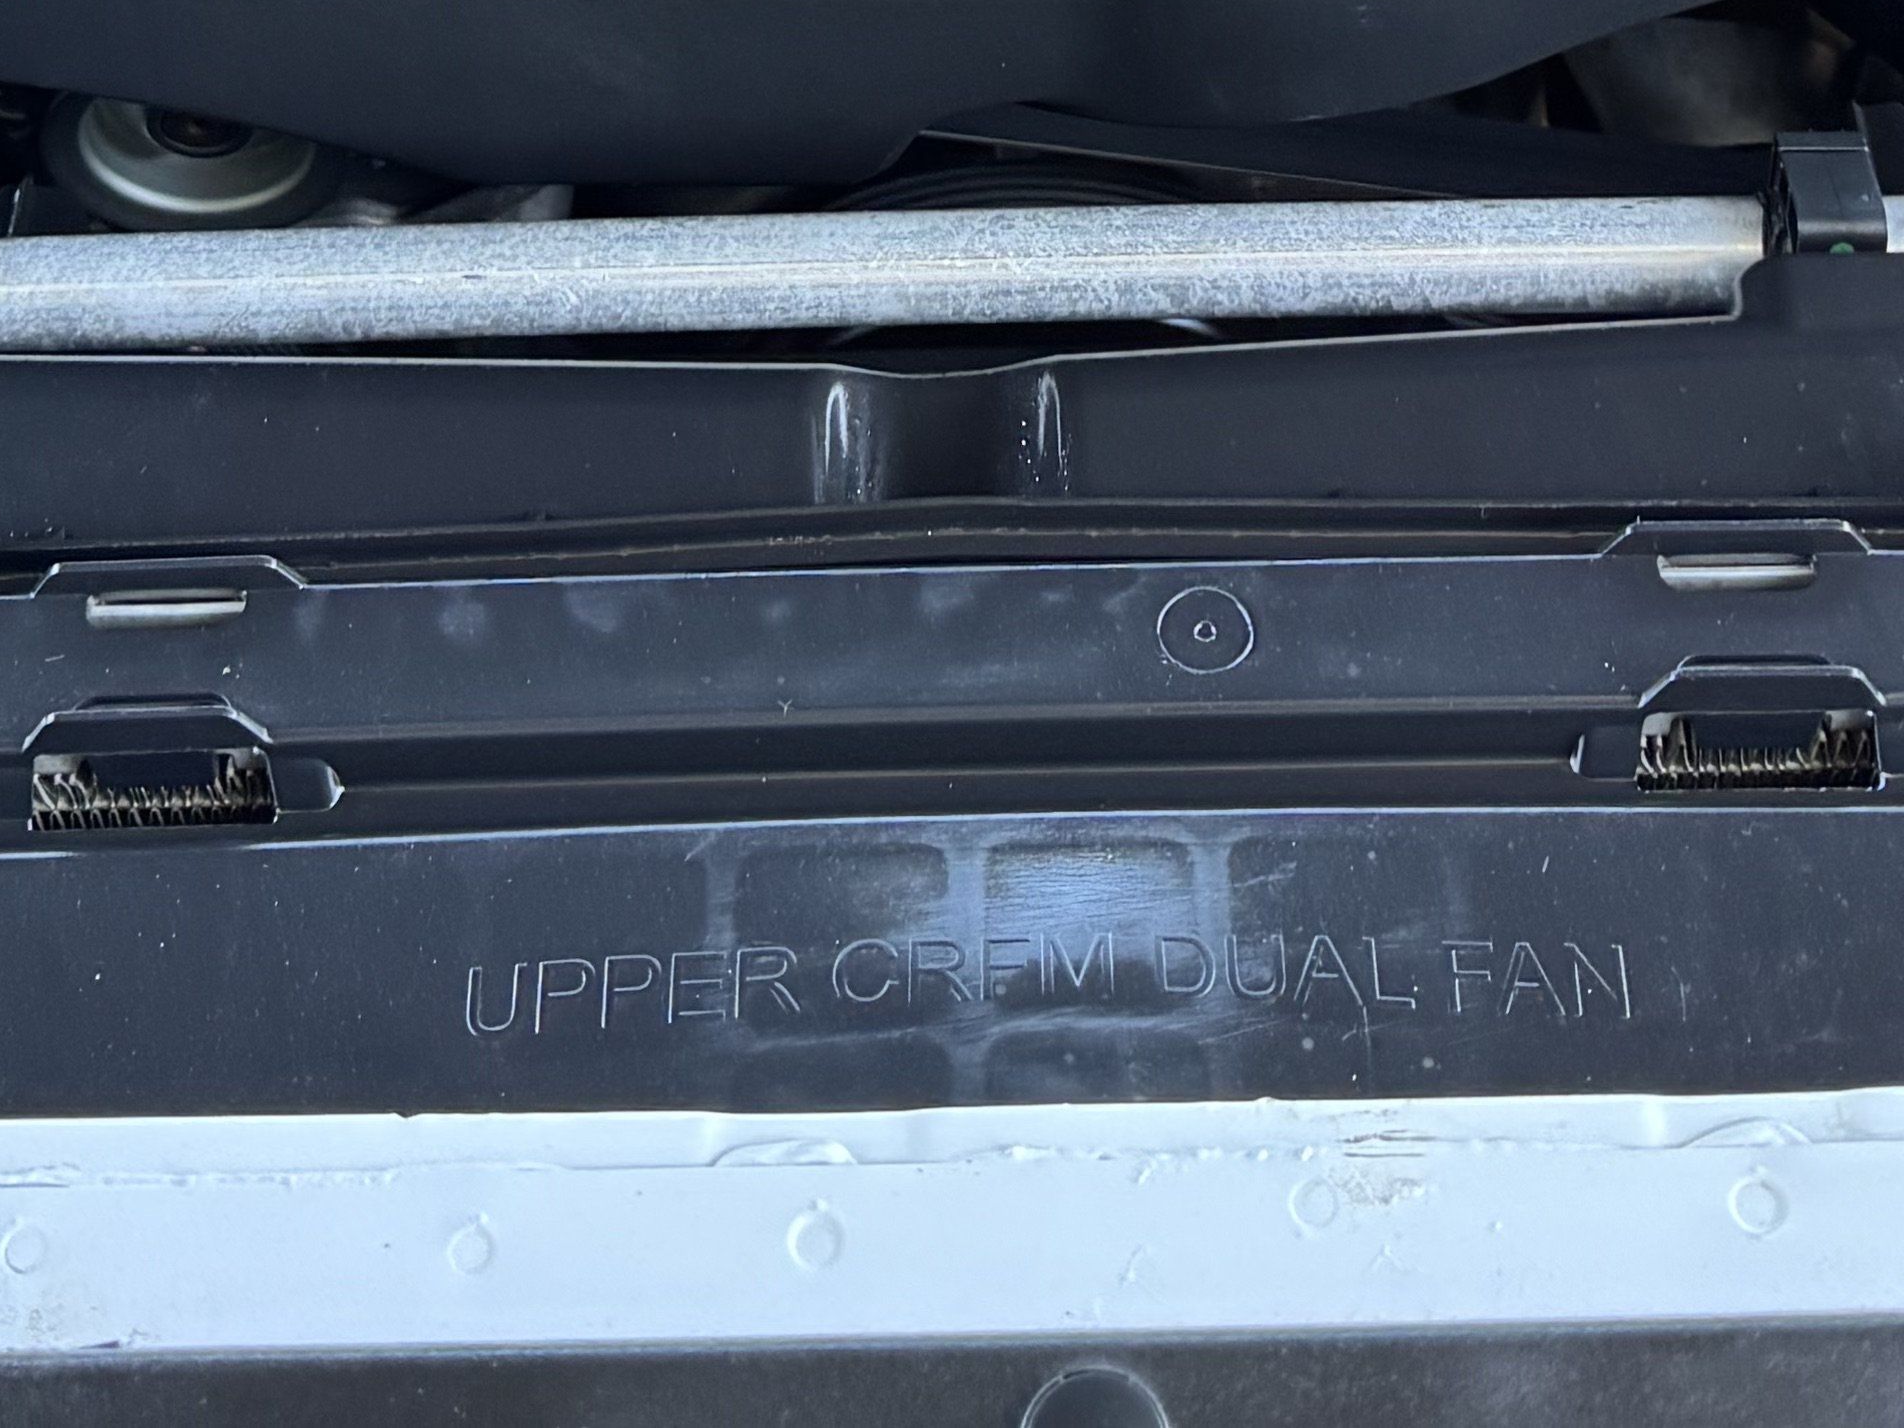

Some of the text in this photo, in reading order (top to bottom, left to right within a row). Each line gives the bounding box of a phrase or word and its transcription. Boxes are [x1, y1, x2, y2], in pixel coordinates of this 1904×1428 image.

[465, 932, 1632, 1037] UPPER CRFM DUAL FAN
